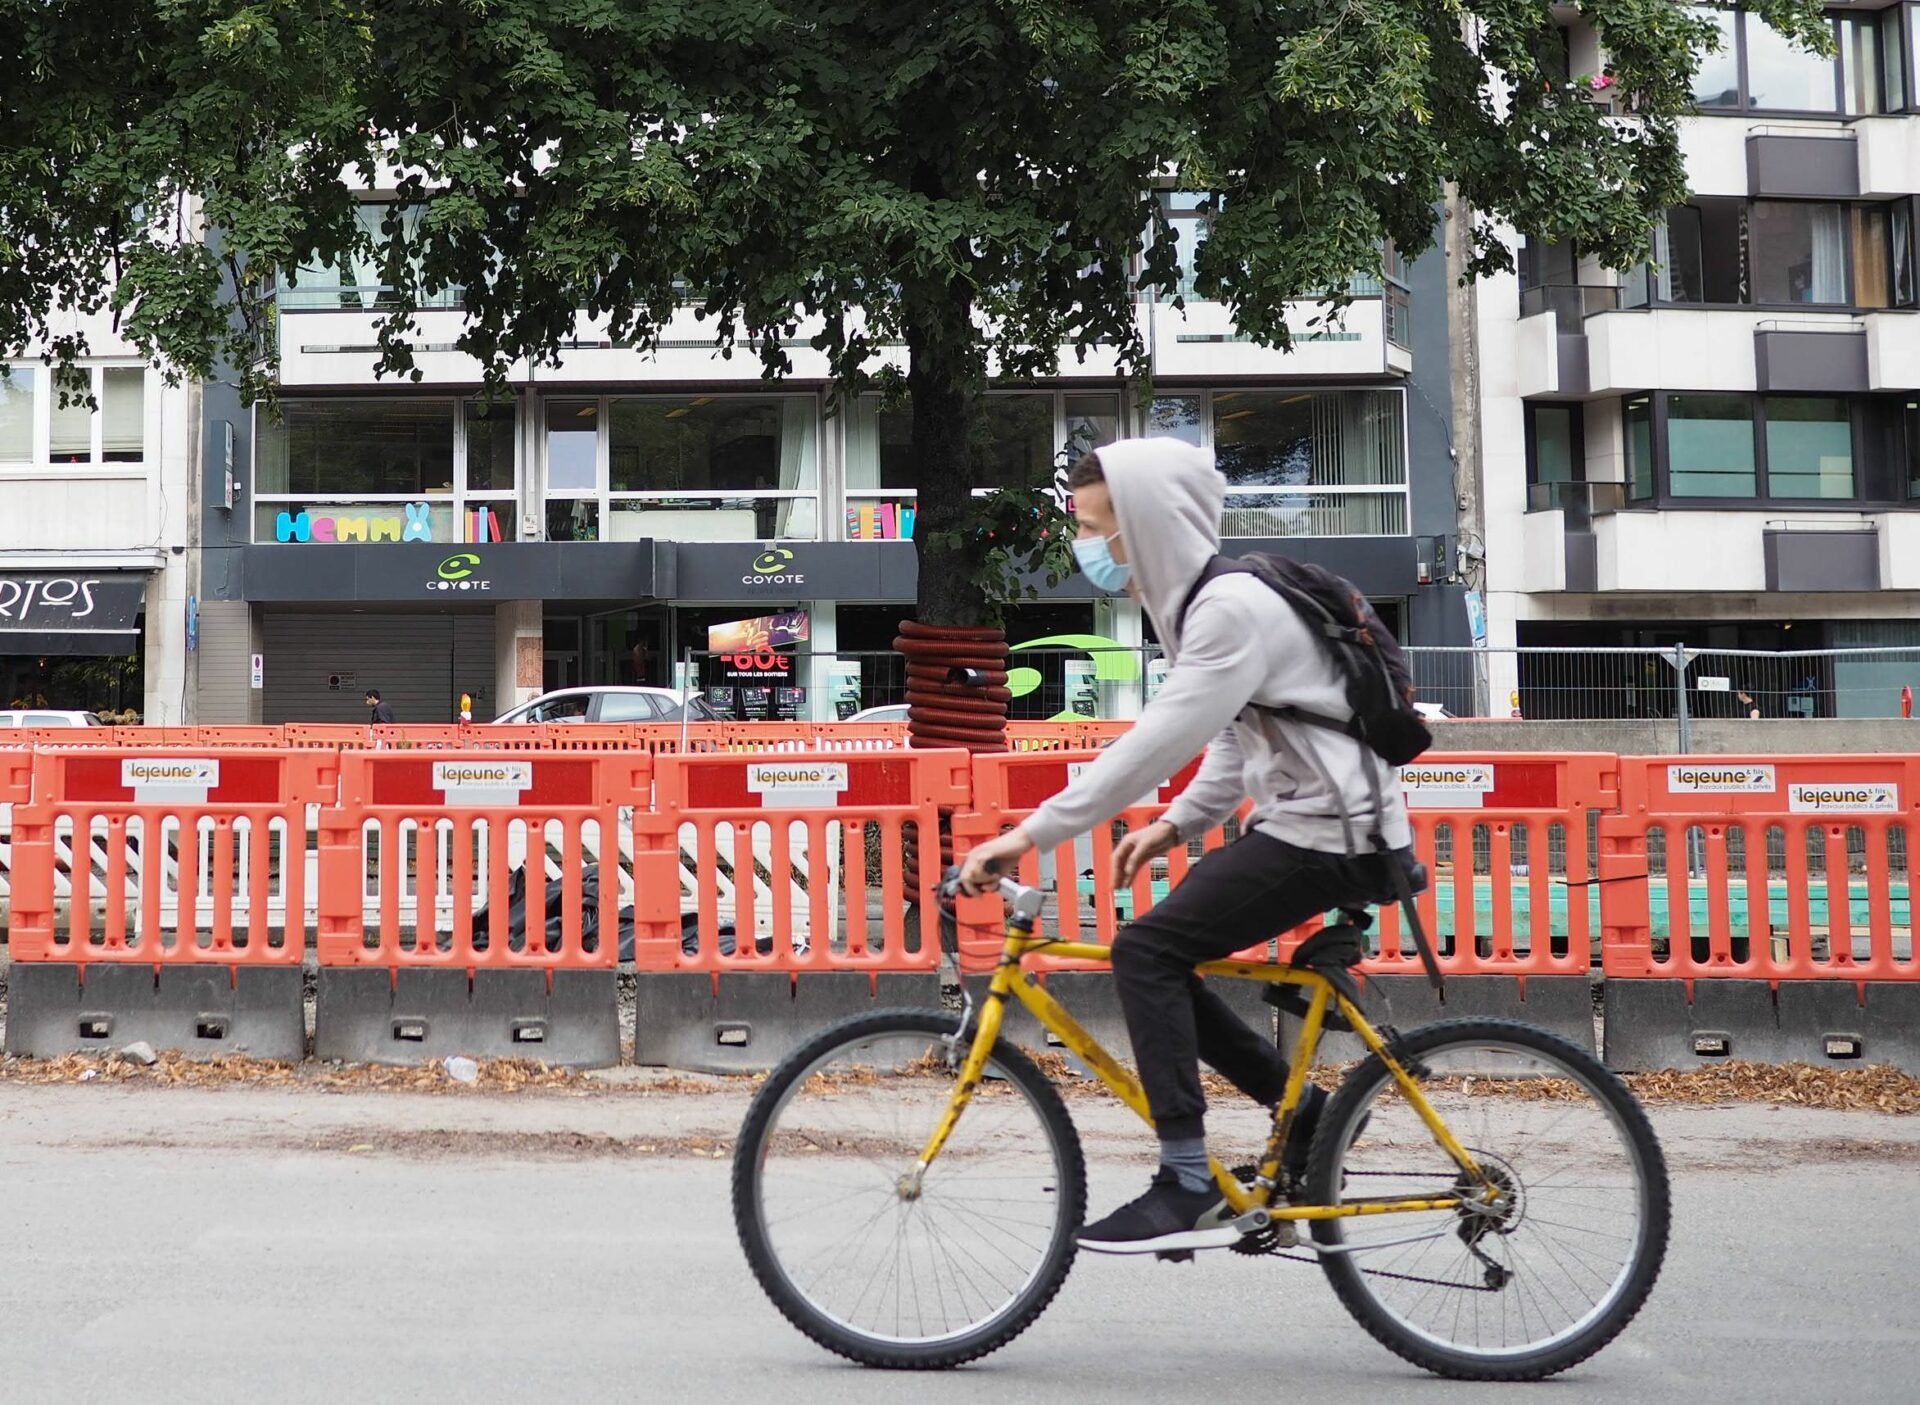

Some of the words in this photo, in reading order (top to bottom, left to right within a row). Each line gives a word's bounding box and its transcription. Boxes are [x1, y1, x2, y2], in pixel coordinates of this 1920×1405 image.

[426, 581, 490, 590] COYOTE
[742, 574, 805, 584] COYOTE
[131, 762, 192, 783] lejeune
[442, 765, 504, 785] lejeune
[757, 768, 820, 788] lejeune
[1401, 767, 1466, 788] lejeune
[1678, 768, 1746, 789] lejeune
[1799, 787, 1868, 808] lejeune
